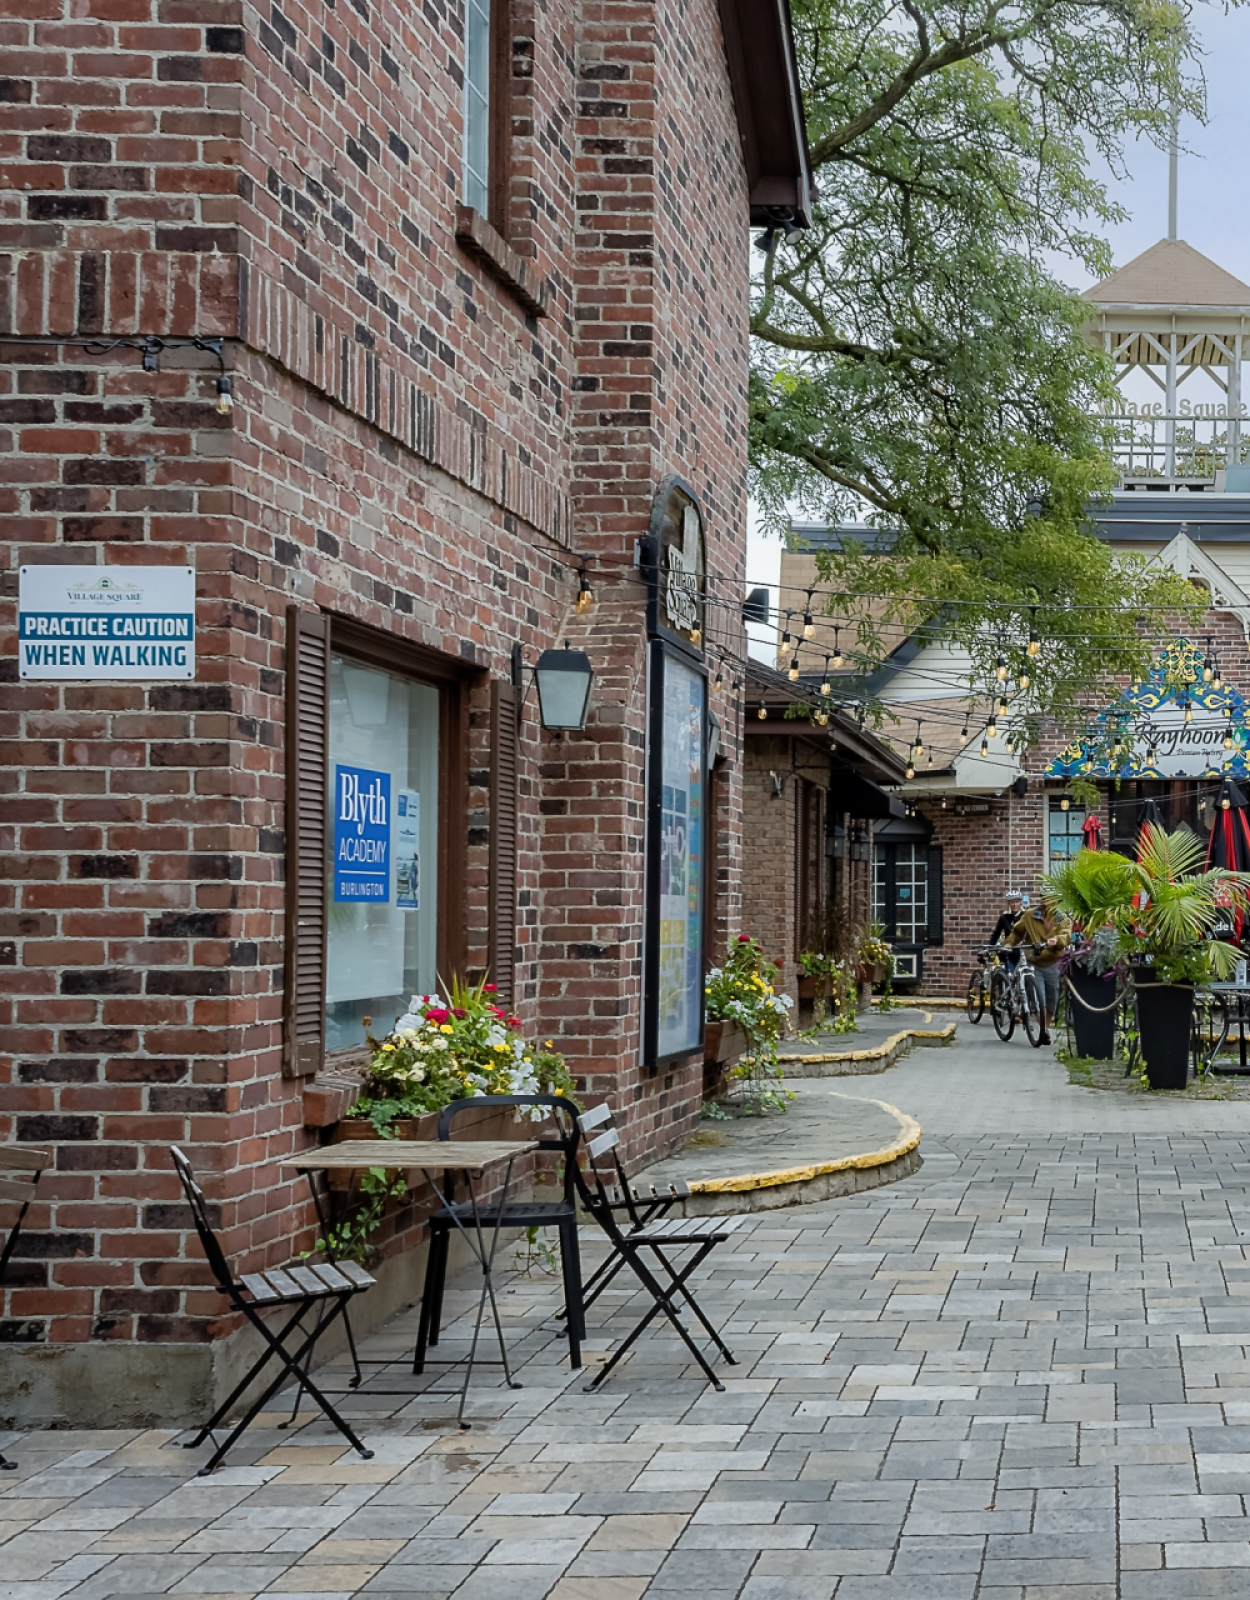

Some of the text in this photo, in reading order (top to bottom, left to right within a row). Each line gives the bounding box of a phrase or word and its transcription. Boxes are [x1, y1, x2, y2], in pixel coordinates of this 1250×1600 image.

[1097, 398, 1162, 421] Vllage
[67, 592, 143, 602] VILLAGE SQUARE
[25, 617, 188, 636] PRACTICE CAUTION
[25, 644, 187, 666] WHEN WALKING
[339, 773, 387, 836] Blyth
[338, 837, 387, 863] ACADEMY
[340, 882, 384, 896] BURLINGTON
